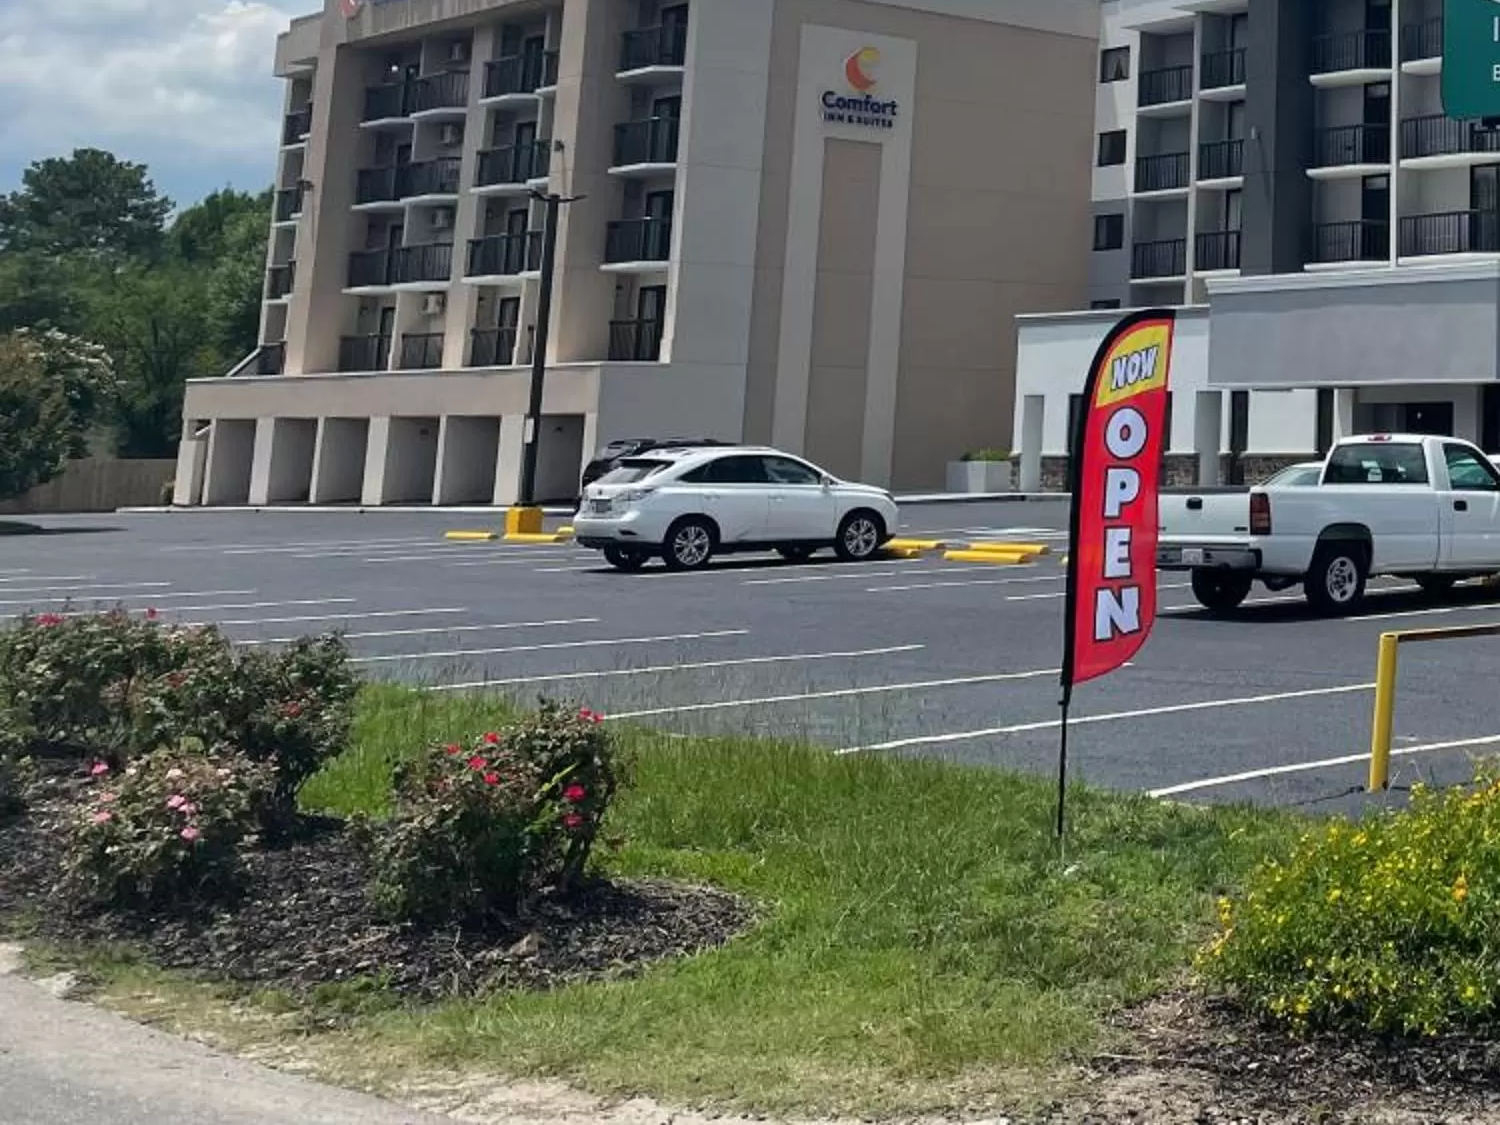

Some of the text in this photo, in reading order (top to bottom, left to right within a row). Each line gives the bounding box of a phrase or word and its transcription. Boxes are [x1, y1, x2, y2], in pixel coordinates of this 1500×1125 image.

[822, 90, 897, 115] Comfort
[1110, 345, 1159, 391] NOW
[1094, 406, 1148, 642] OPEN
